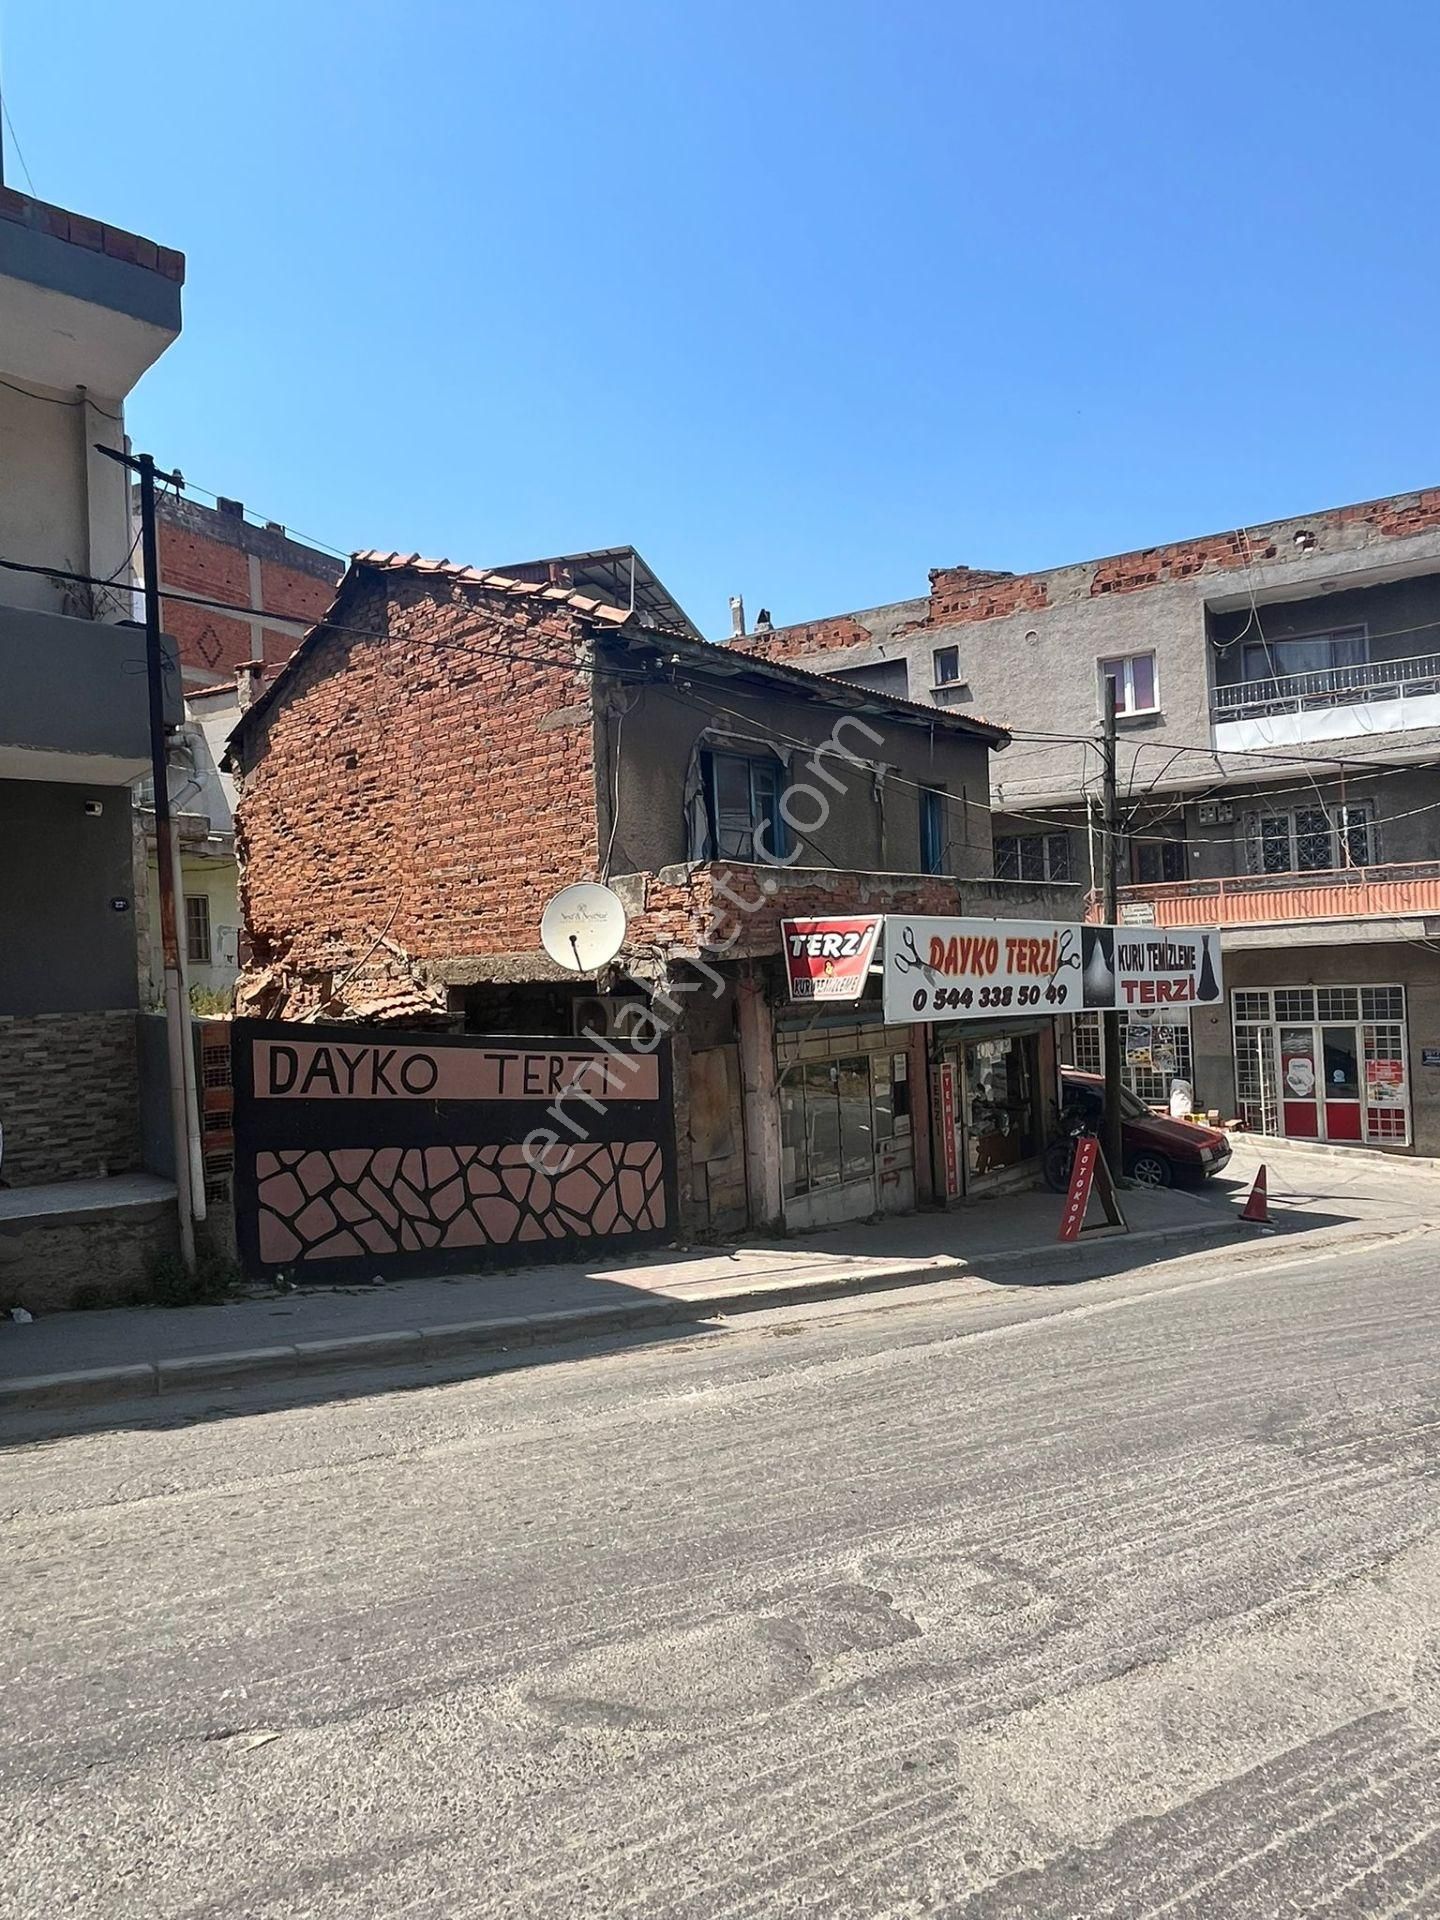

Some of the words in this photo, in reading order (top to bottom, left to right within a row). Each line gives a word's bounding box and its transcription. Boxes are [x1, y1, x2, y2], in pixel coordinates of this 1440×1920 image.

[928, 934, 999, 978] DAYKO
[1005, 929, 1059, 977] TERZİ
[1118, 943, 1145, 972] KURU
[912, 988, 928, 1012] 0
[933, 986, 974, 1011] 544
[978, 985, 1013, 1008] 338
[1017, 984, 1041, 1006] 50
[1045, 983, 1068, 1005] 49
[1121, 974, 1196, 1004] TERZİ
[269, 1045, 438, 1095] DAYKO
